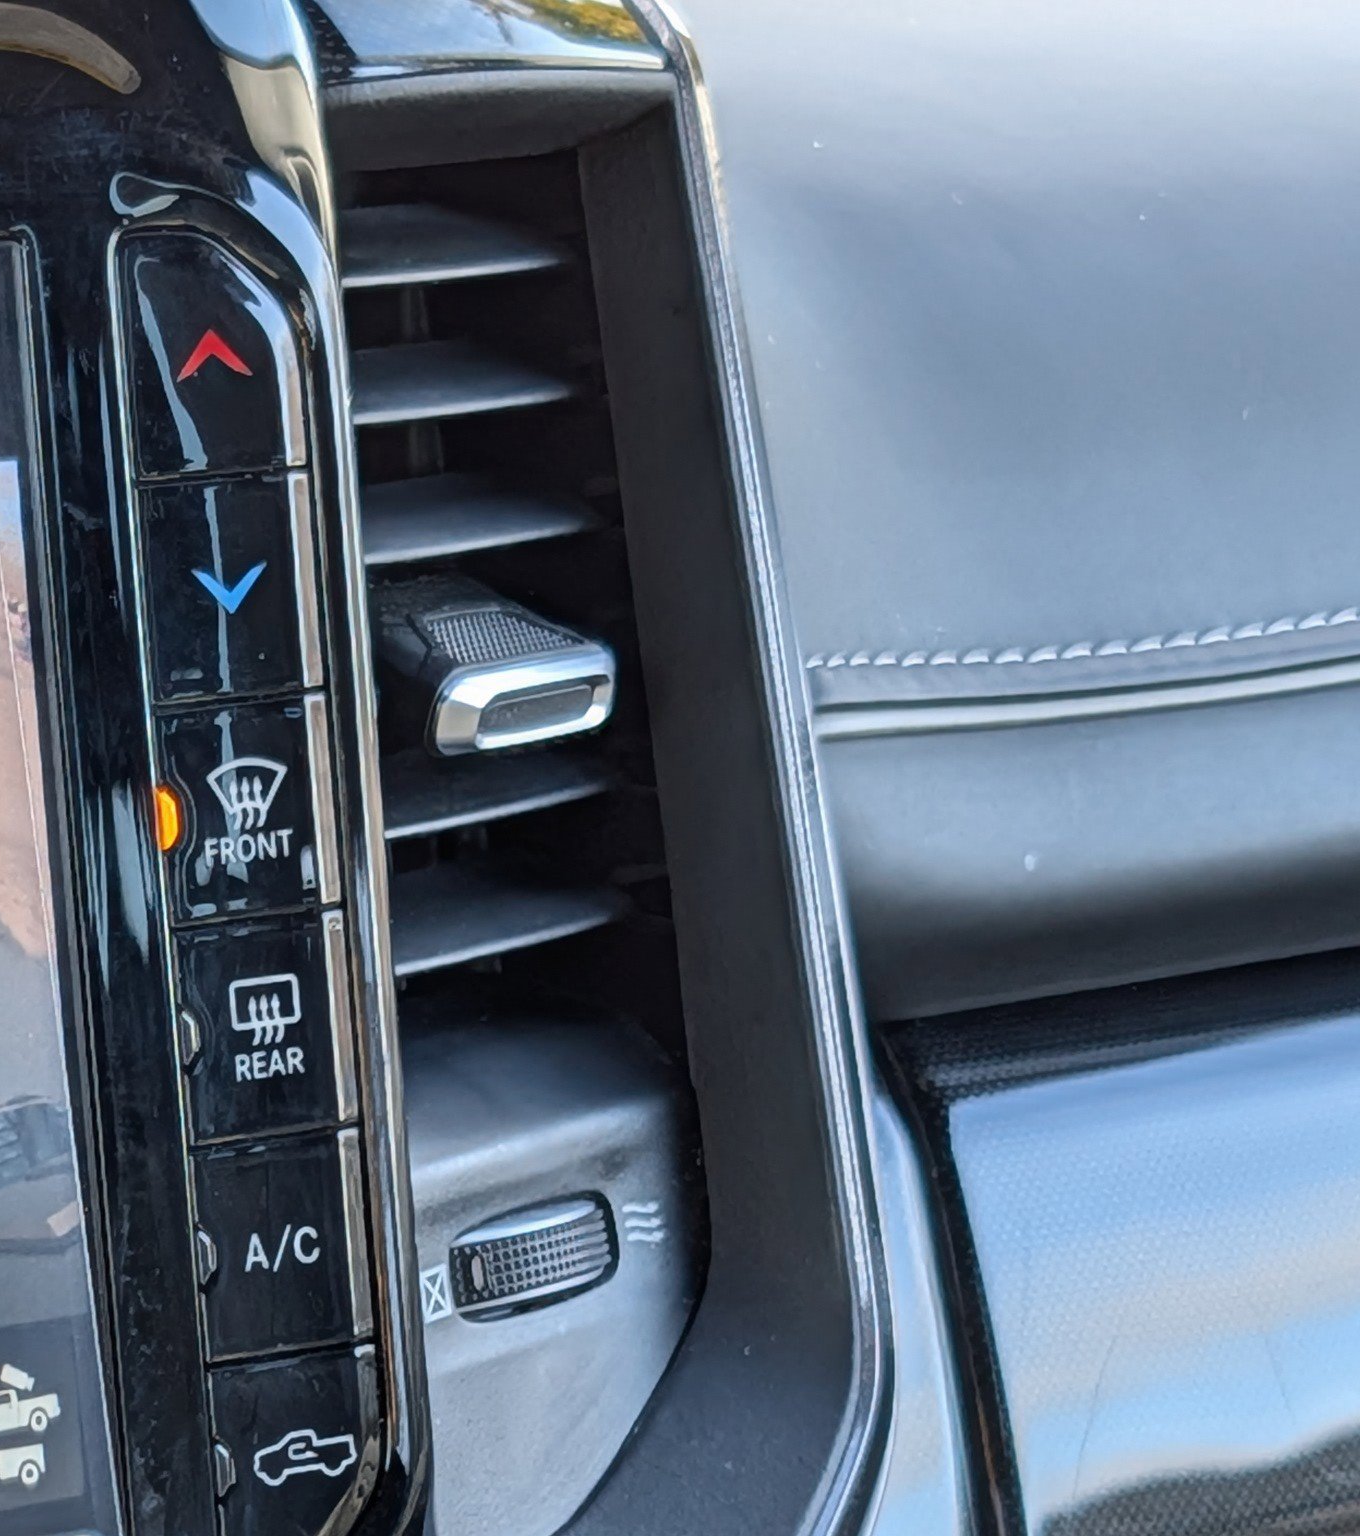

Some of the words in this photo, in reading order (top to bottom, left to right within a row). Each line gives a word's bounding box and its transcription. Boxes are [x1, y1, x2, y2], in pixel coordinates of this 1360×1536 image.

[204, 828, 293, 865] FRONT
[235, 1047, 305, 1081] REAR
[245, 1225, 321, 1272] A/C
